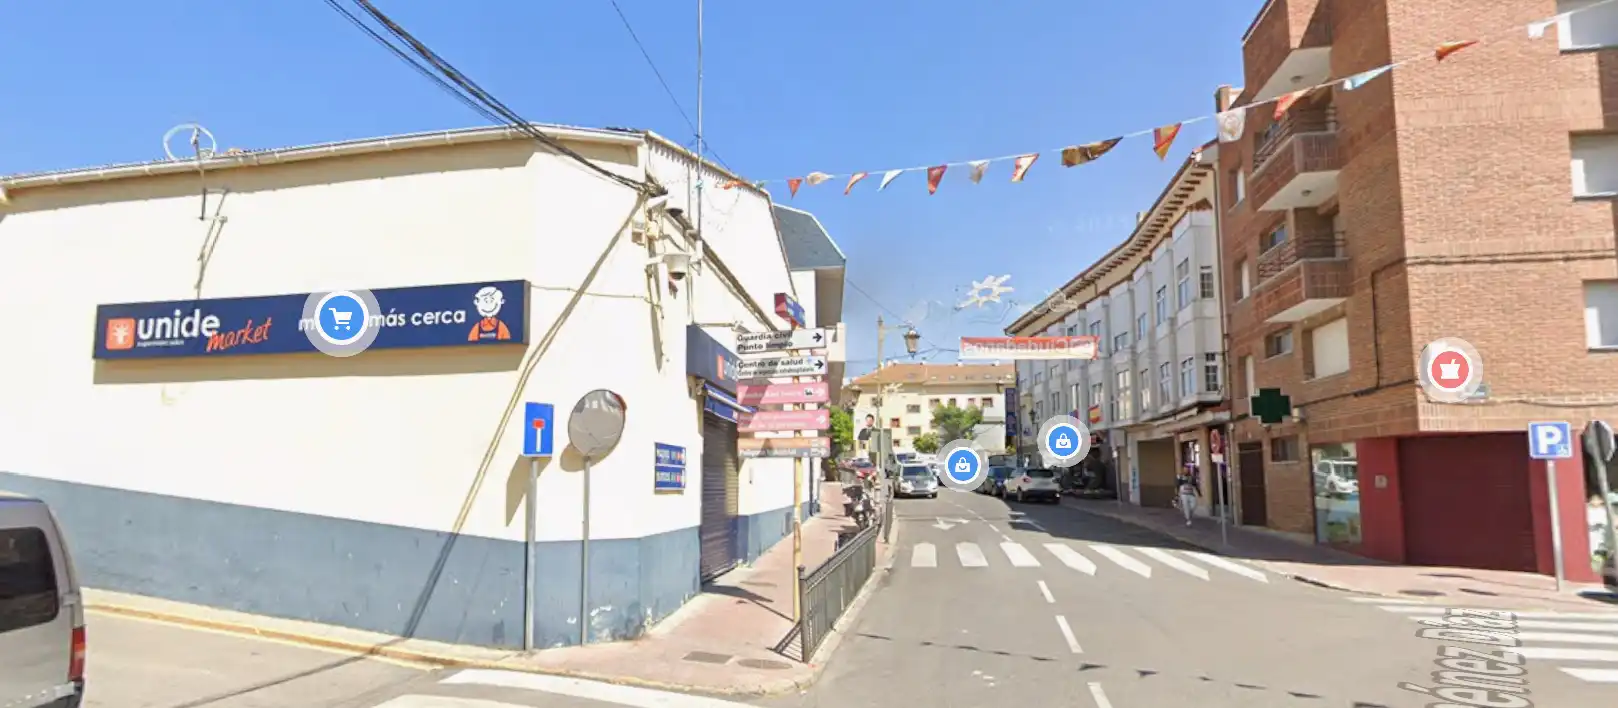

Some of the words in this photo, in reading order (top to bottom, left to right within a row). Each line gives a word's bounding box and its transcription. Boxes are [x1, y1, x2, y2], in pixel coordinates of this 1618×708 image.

[137, 308, 221, 340] unide
[368, 309, 405, 328] más
[411, 310, 466, 326] cerca
[206, 317, 273, 352] market
[737, 332, 771, 341] Guardia
[737, 343, 764, 351] Punto
[738, 360, 766, 368] Centro
[781, 358, 804, 366] salud
[1538, 425, 1562, 454] P
